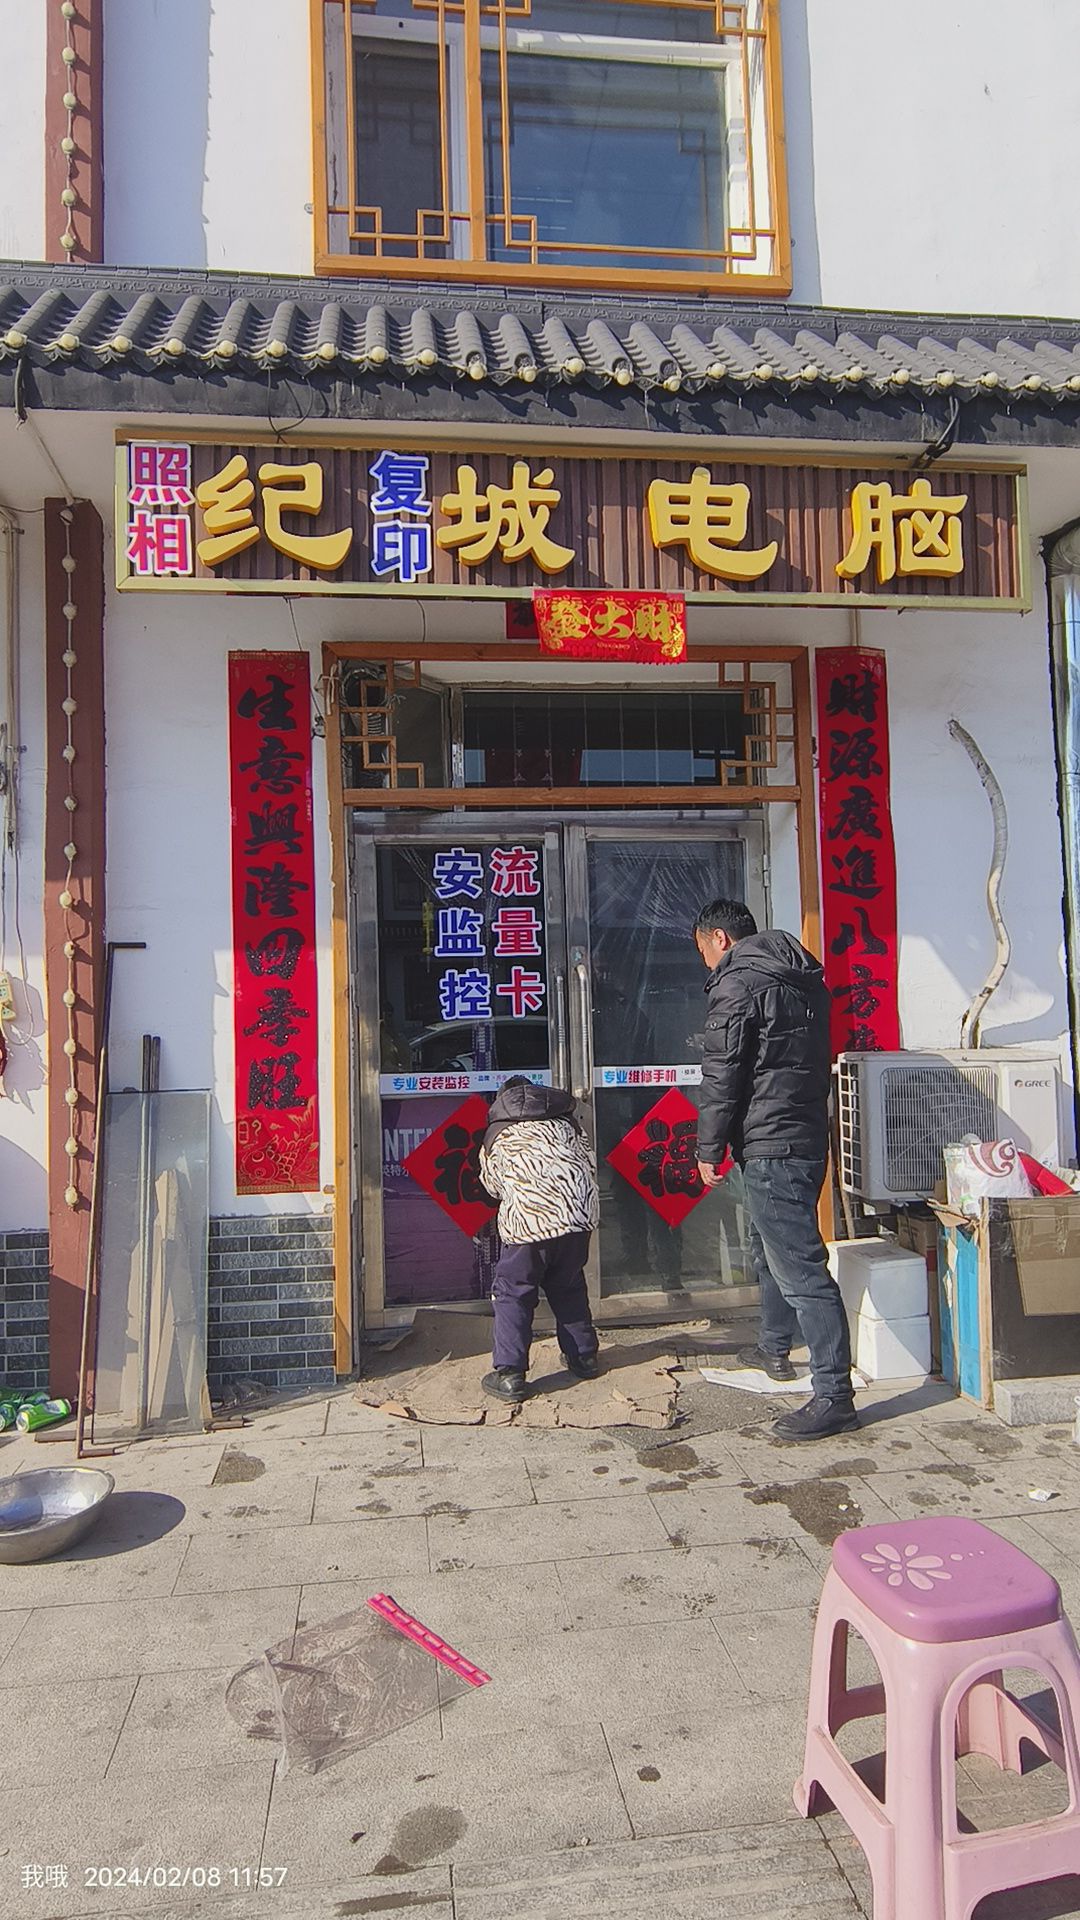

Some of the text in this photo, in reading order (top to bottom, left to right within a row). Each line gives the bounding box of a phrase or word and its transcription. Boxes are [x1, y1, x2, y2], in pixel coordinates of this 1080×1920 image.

[128, 441, 195, 575] 照相
[370, 450, 433, 583] 复印
[392, 1075, 471, 1091] 专业安装监控
[604, 1069, 677, 1084] 专业维修手机
